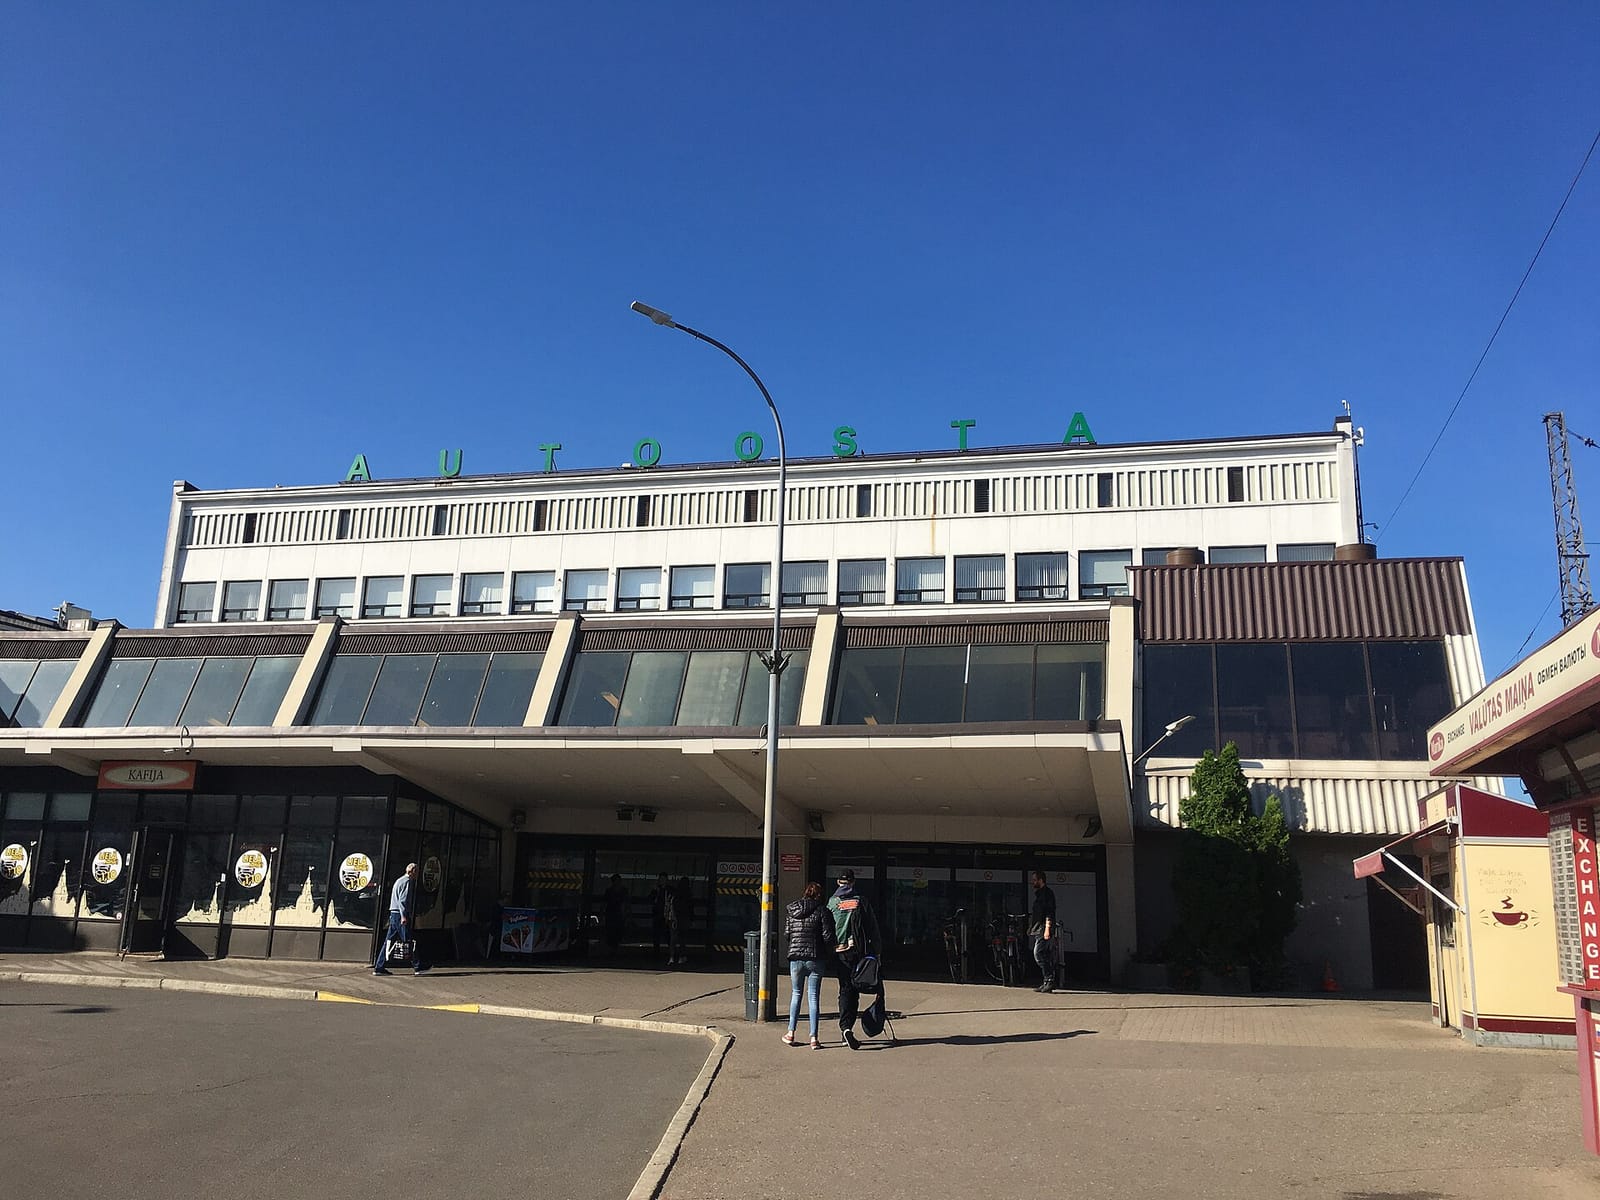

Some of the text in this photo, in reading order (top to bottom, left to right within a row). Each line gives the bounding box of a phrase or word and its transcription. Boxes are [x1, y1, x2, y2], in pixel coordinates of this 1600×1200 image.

[346, 413, 1095, 481] AUTOOSTA
[1537, 643, 1587, 685] ОБМЕН ВАЛЮТЫ
[1469, 692, 1503, 735] VALŪTAS
[1505, 672, 1535, 709] MAIŅA
[128, 769, 164, 783] KAFIJA
[1577, 818, 1600, 980] EXCHANGE
